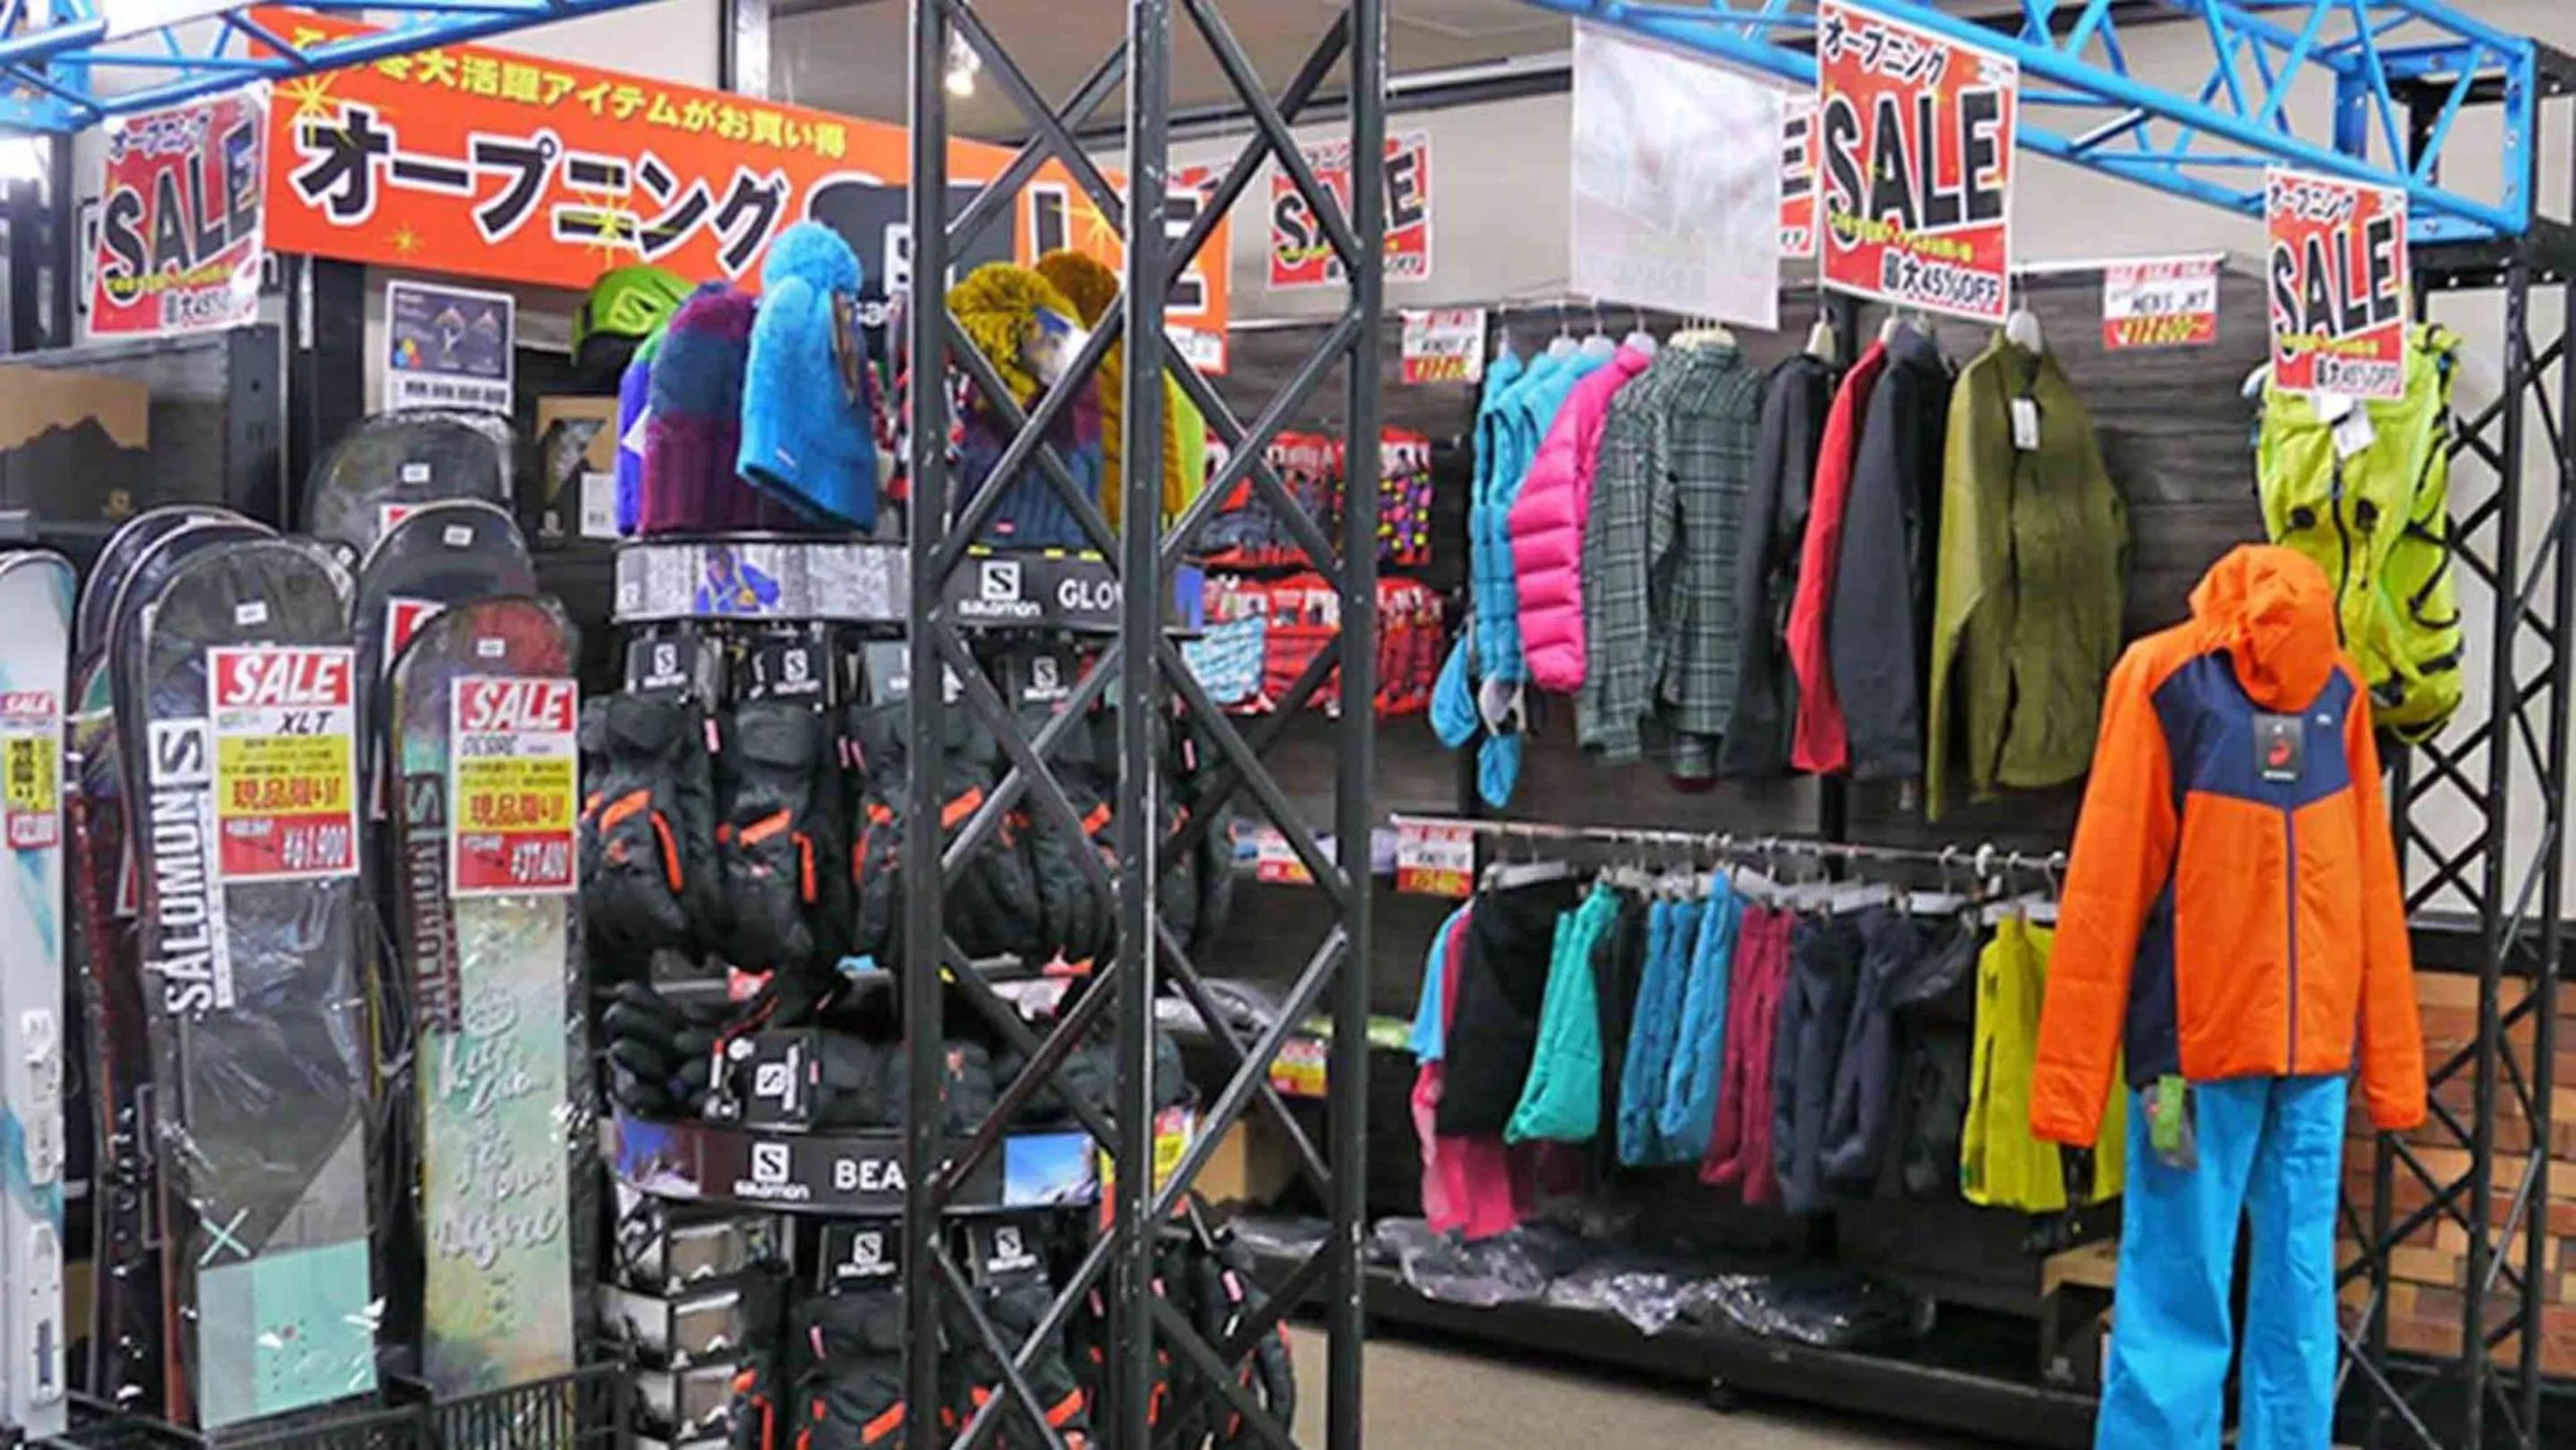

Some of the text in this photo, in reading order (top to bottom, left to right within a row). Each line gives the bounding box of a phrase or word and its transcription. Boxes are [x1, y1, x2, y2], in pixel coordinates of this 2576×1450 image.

[1824, 16, 1945, 86] オープニング
[105, 120, 259, 301] SALE
[297, 107, 786, 272] オープニング
[1275, 152, 1424, 263] SE
[1824, 90, 2002, 244] SALE
[2273, 218, 2401, 356] SALE
[226, 653, 344, 705] SALE
[276, 711, 334, 735] XLT
[467, 682, 572, 729] SALE
[834, 1160, 907, 1191] BEA
